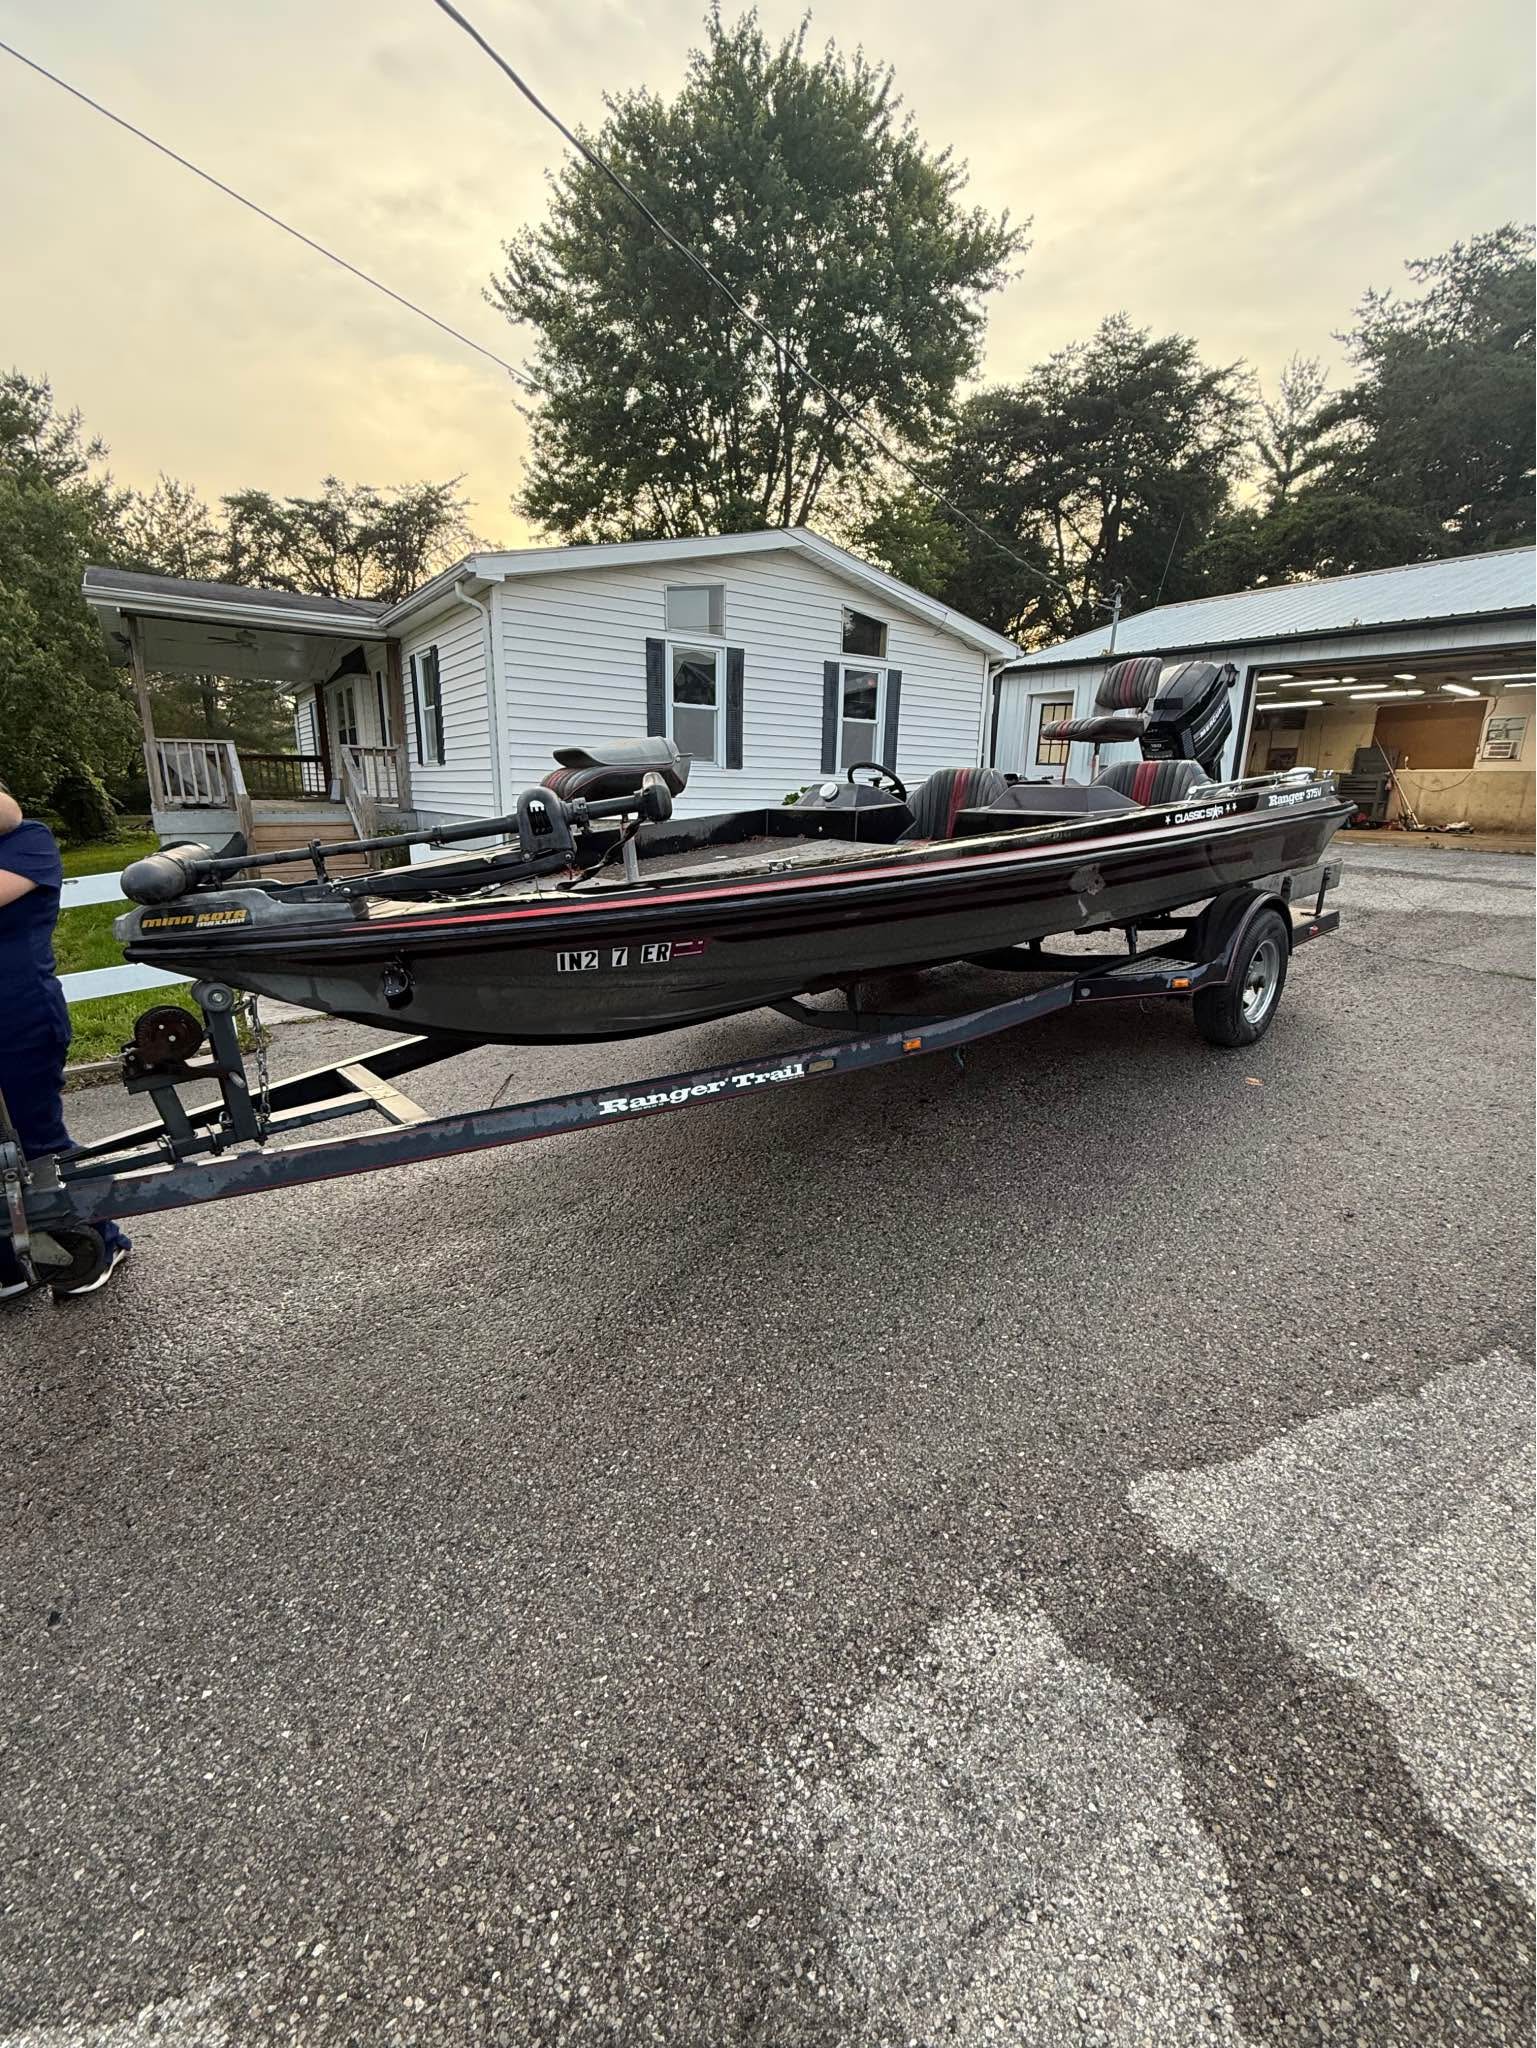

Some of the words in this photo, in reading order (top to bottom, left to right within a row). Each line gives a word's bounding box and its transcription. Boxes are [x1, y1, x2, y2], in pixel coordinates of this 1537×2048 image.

[1268, 790, 1305, 807] Ranger
[1174, 809, 1207, 824] CLASSIC
[558, 951, 598, 971] IN2
[613, 947, 627, 966] 7
[641, 943, 671, 963] ER
[598, 1079, 728, 1115] Ranger
[731, 1063, 805, 1088] Trail
